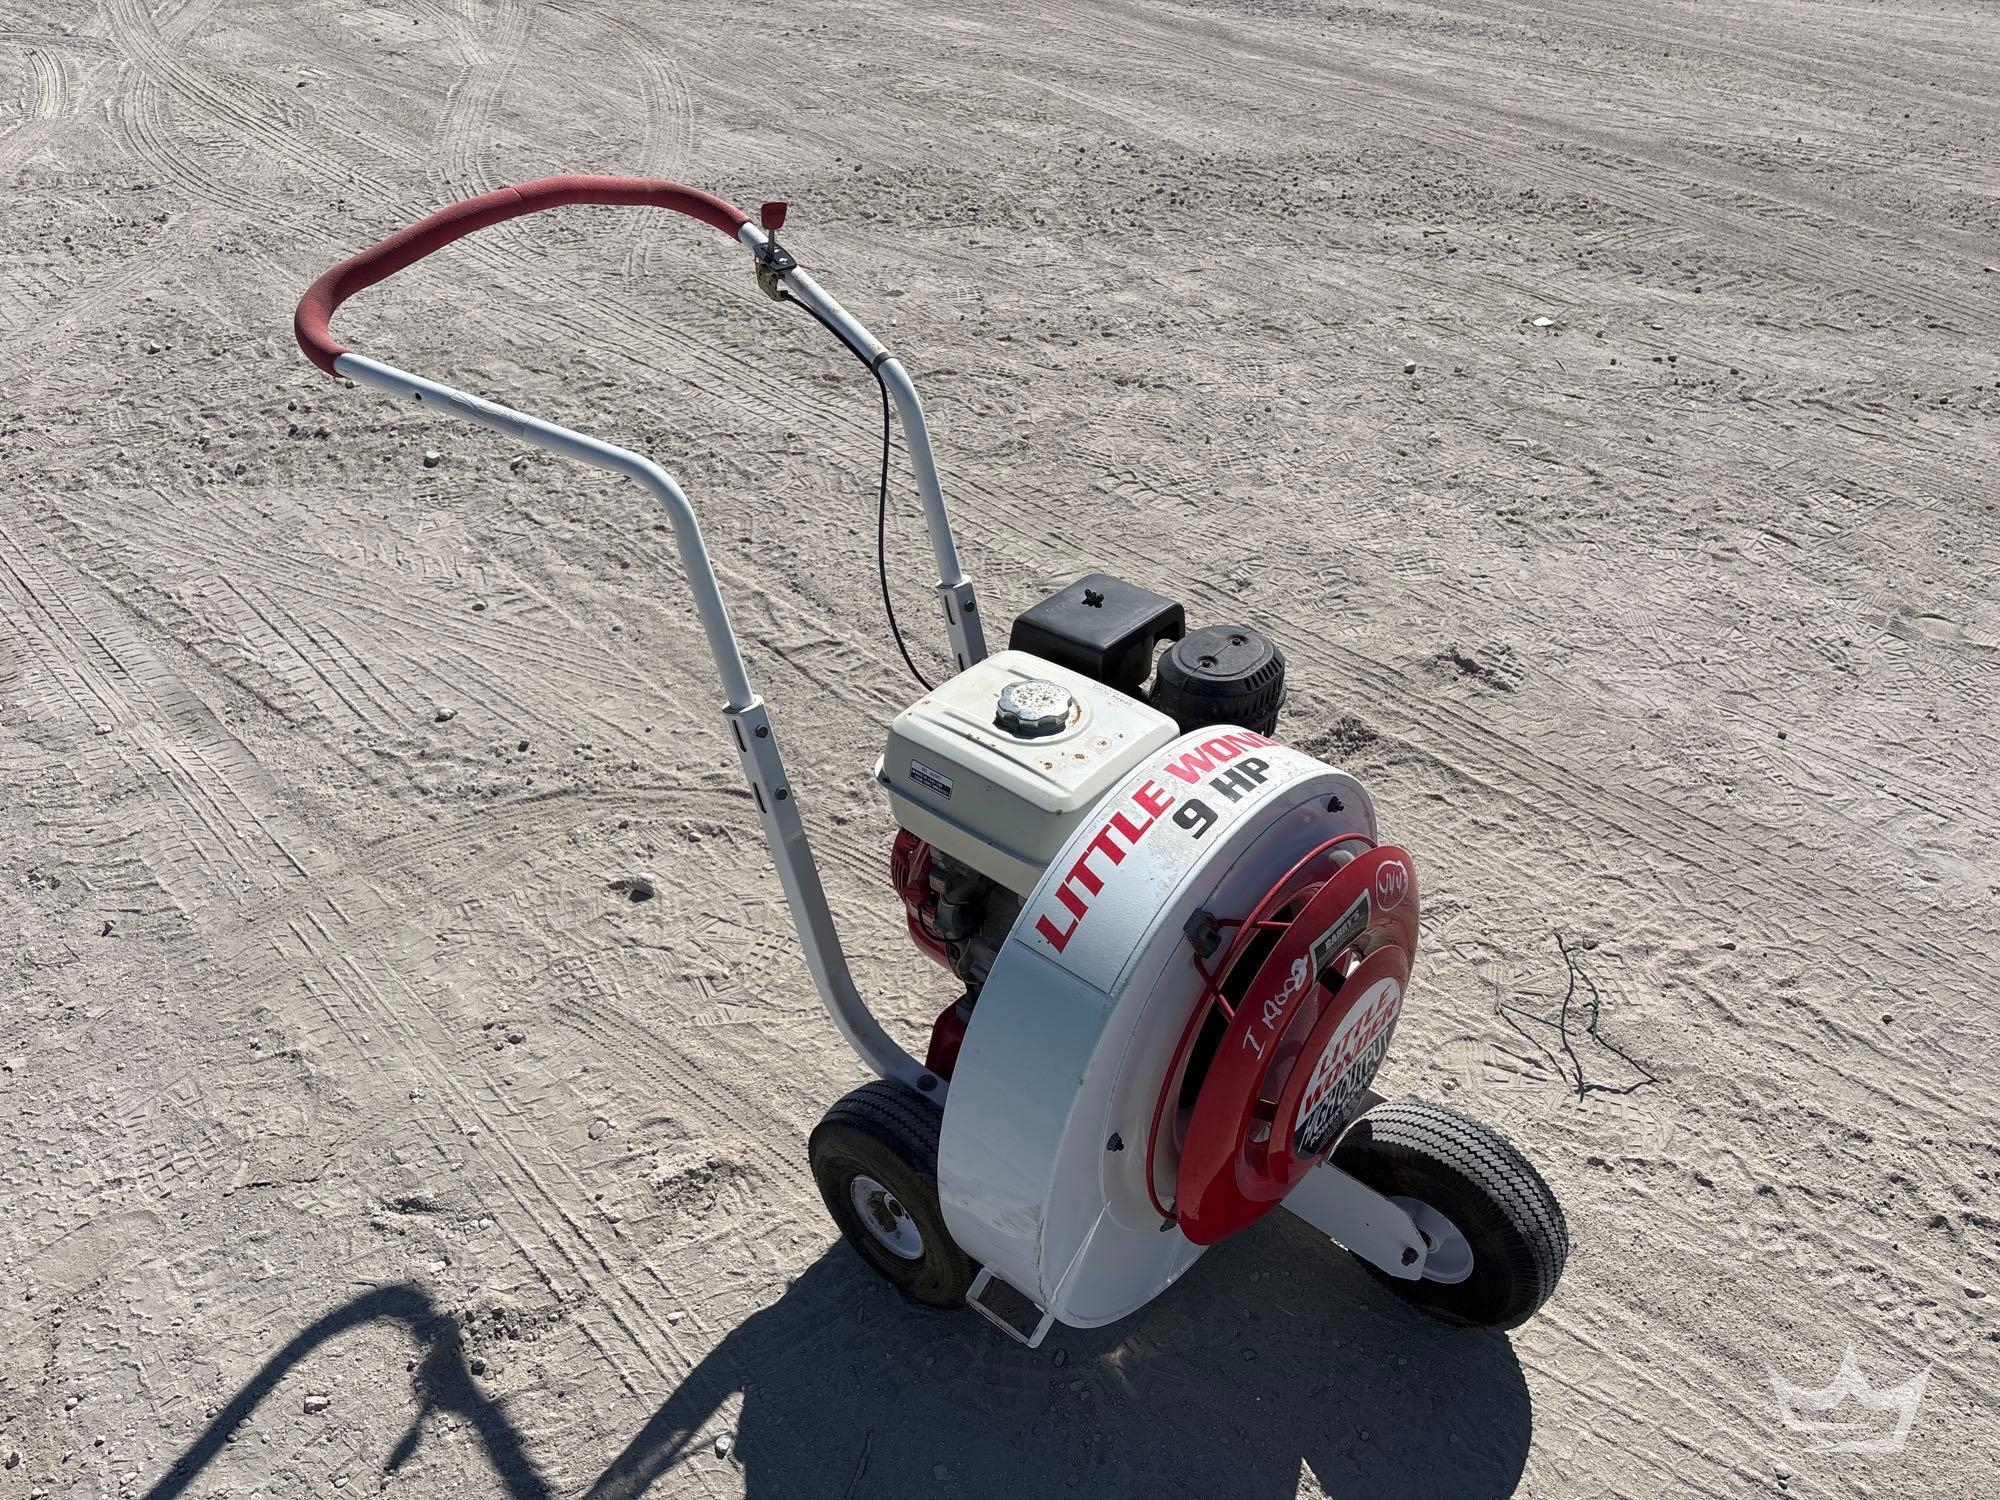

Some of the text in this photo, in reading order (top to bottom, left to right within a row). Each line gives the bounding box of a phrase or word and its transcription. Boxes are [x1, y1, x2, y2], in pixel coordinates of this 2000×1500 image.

[1172, 757, 1270, 840] 9 HP
[1035, 779, 1176, 954] LITTLE
[1325, 910, 1360, 950] BARRY'S
[1304, 997, 1397, 1115] WONDER
[1318, 983, 1392, 1080] LITTLE
[1336, 1026, 1389, 1106] OUTPUT
